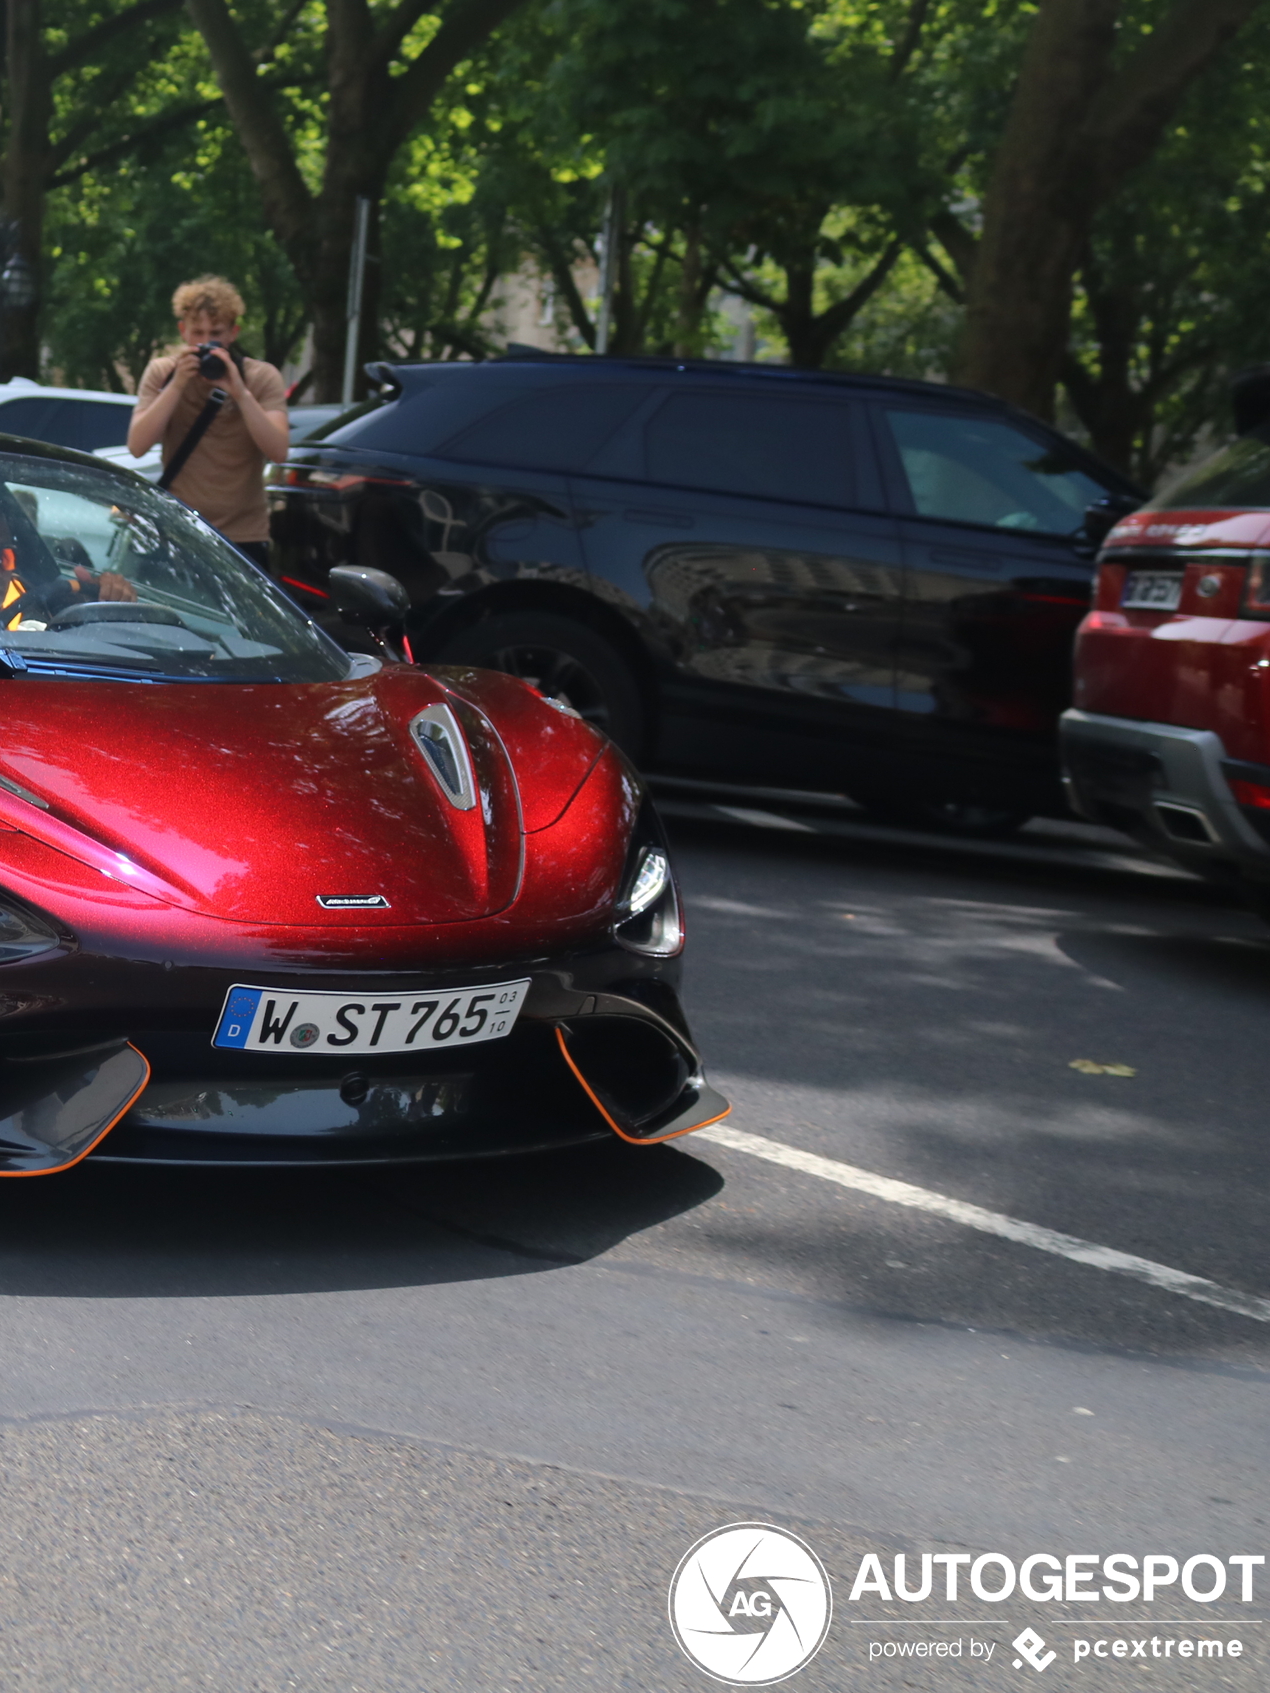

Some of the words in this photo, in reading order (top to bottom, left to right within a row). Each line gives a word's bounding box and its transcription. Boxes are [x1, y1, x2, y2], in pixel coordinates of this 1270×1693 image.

[499, 991, 517, 1004] 03
[227, 1024, 241, 1037] D
[259, 999, 299, 1044] W
[327, 1003, 401, 1047] ST
[405, 993, 496, 1042] 765
[489, 1020, 506, 1034] 10
